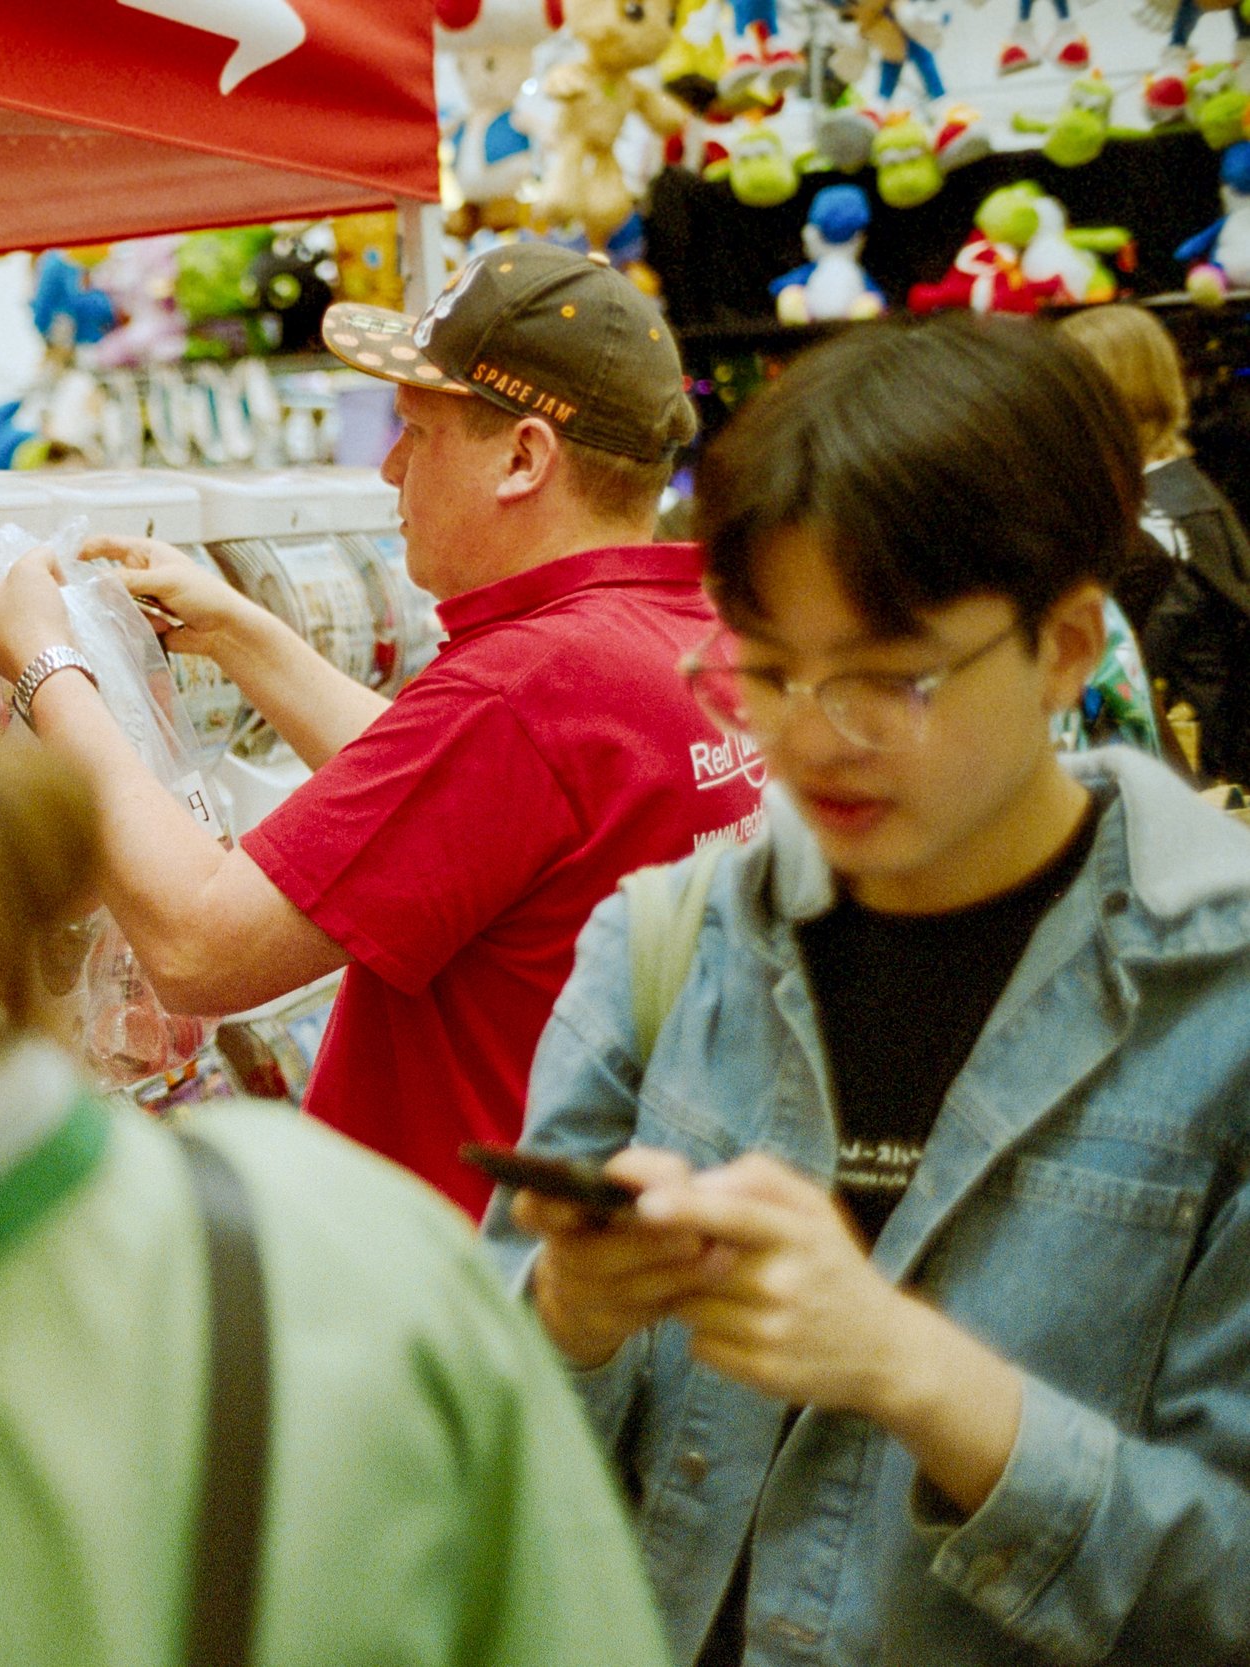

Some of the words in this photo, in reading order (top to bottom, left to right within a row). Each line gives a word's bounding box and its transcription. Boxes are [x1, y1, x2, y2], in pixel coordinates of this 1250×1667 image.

[473, 364, 532, 402] SPACE
[532, 393, 574, 423] JAM
[690, 733, 734, 781] Red
